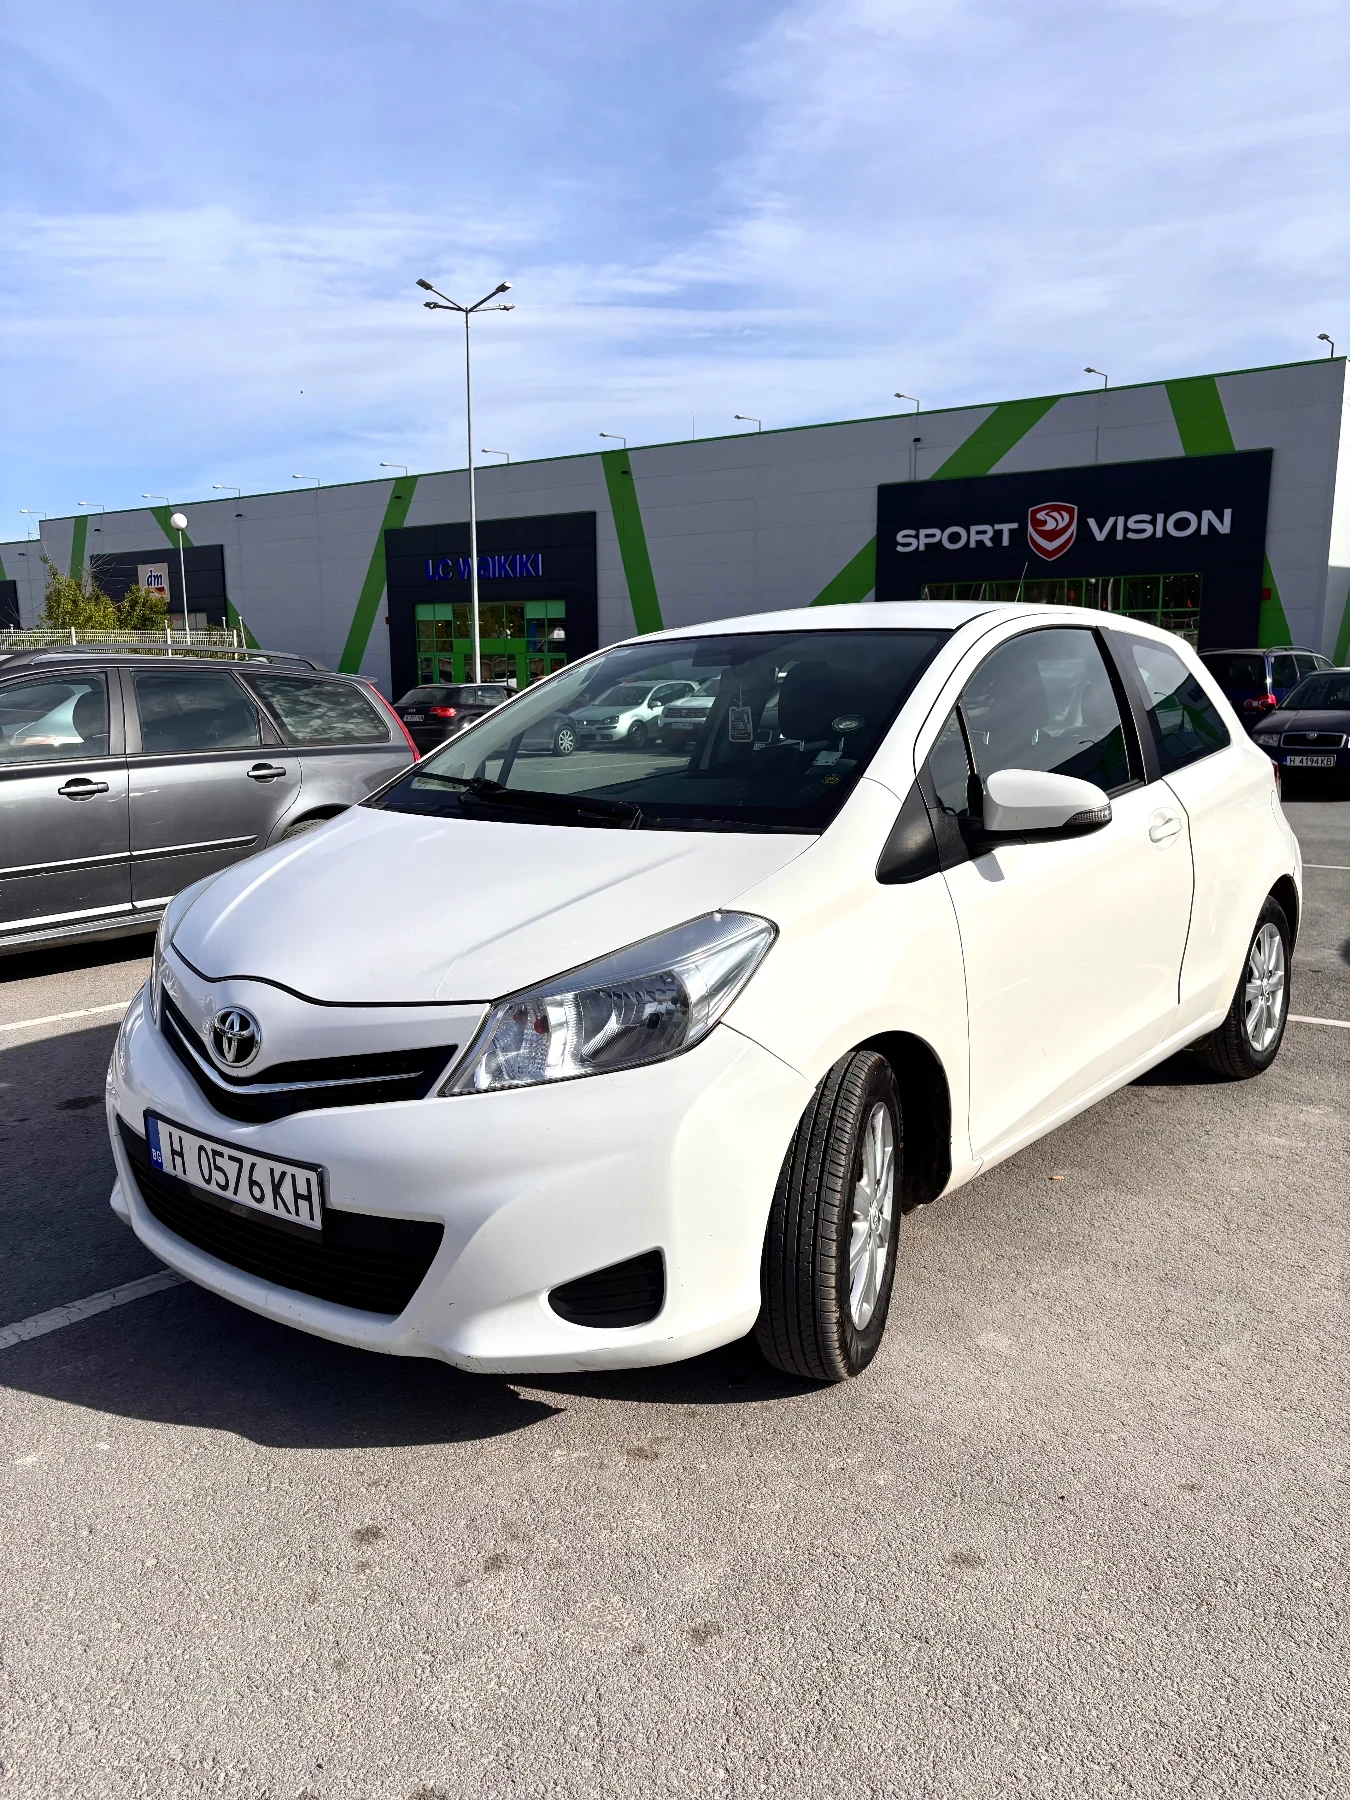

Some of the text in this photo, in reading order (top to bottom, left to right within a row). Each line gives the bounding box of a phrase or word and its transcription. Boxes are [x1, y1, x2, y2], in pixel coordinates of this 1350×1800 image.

[895, 522, 1019, 553] SPORT
[1086, 508, 1233, 542] VISION
[146, 569, 163, 588] dm
[425, 557, 453, 581] LC
[151, 1148, 162, 1163] BG
[168, 1131, 187, 1176] H
